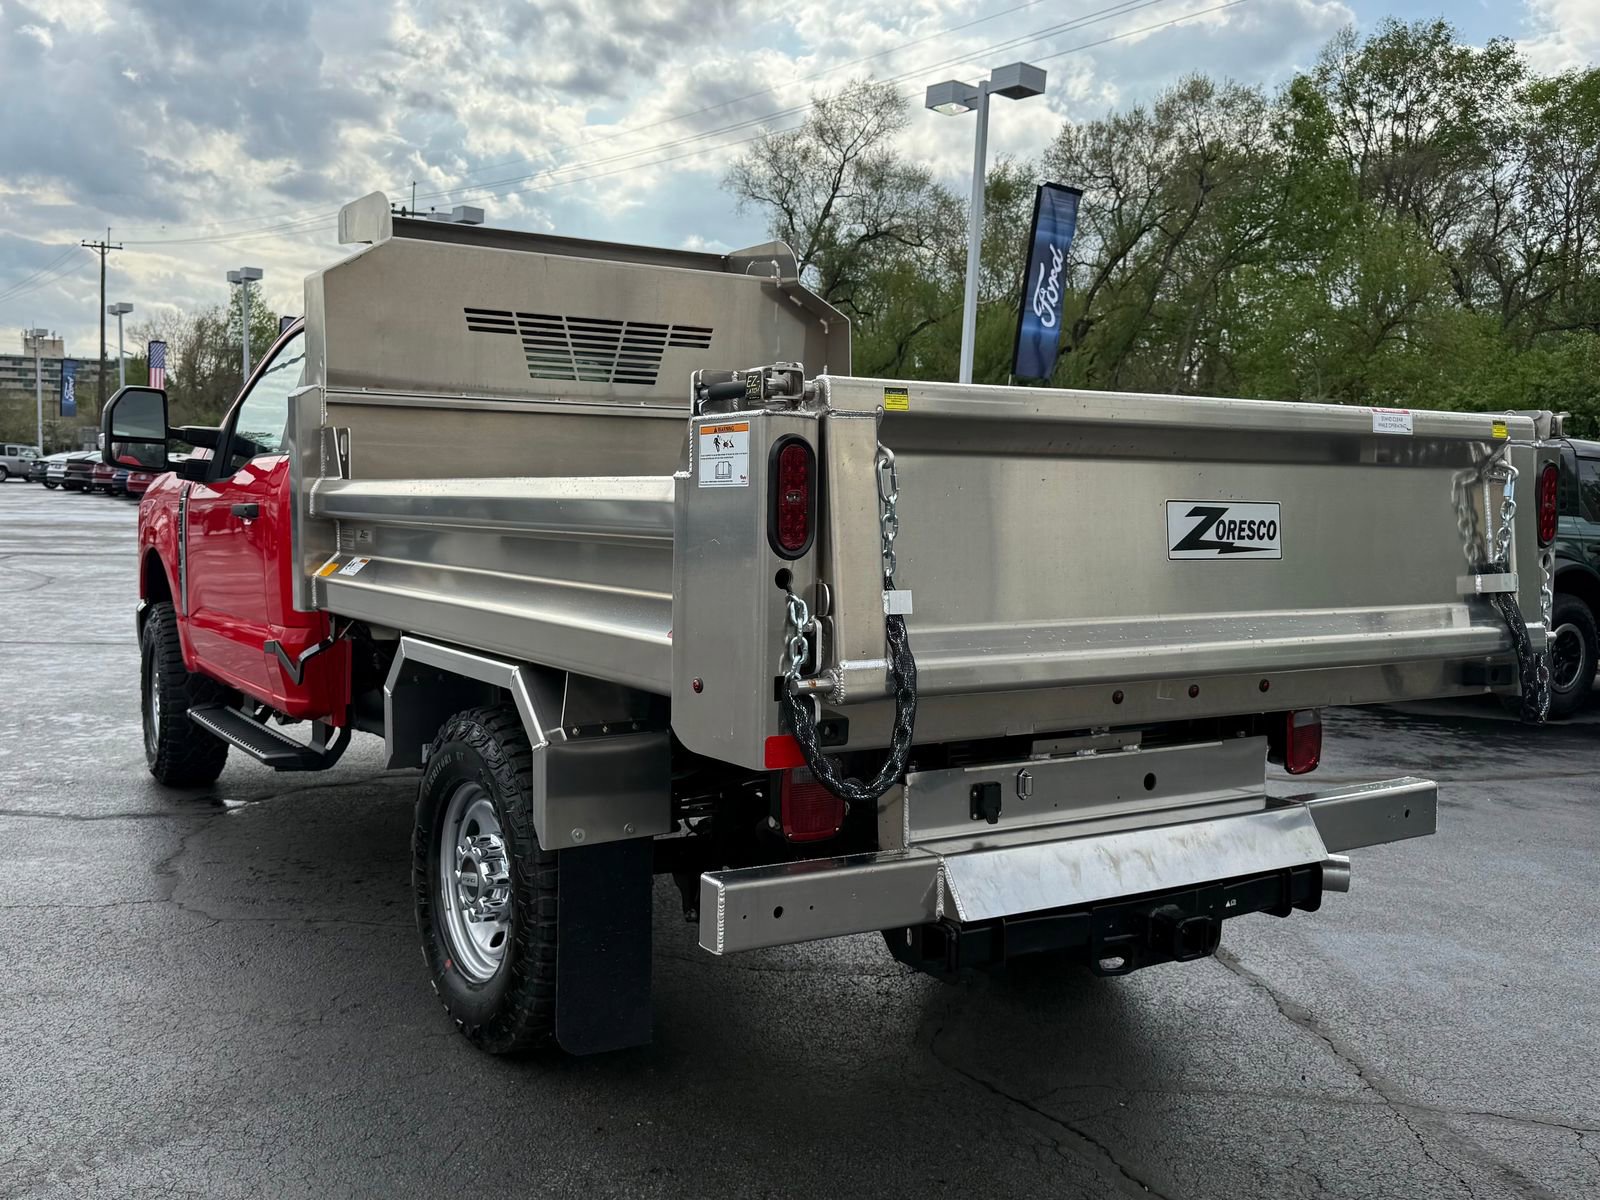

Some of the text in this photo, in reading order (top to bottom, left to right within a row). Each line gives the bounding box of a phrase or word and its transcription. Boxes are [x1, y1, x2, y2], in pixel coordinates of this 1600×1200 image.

[1033, 244, 1063, 328] Ford
[64, 376, 75, 402] Ford
[718, 425, 735, 433] WARNING
[1171, 506, 1278, 554] ZORESCO
